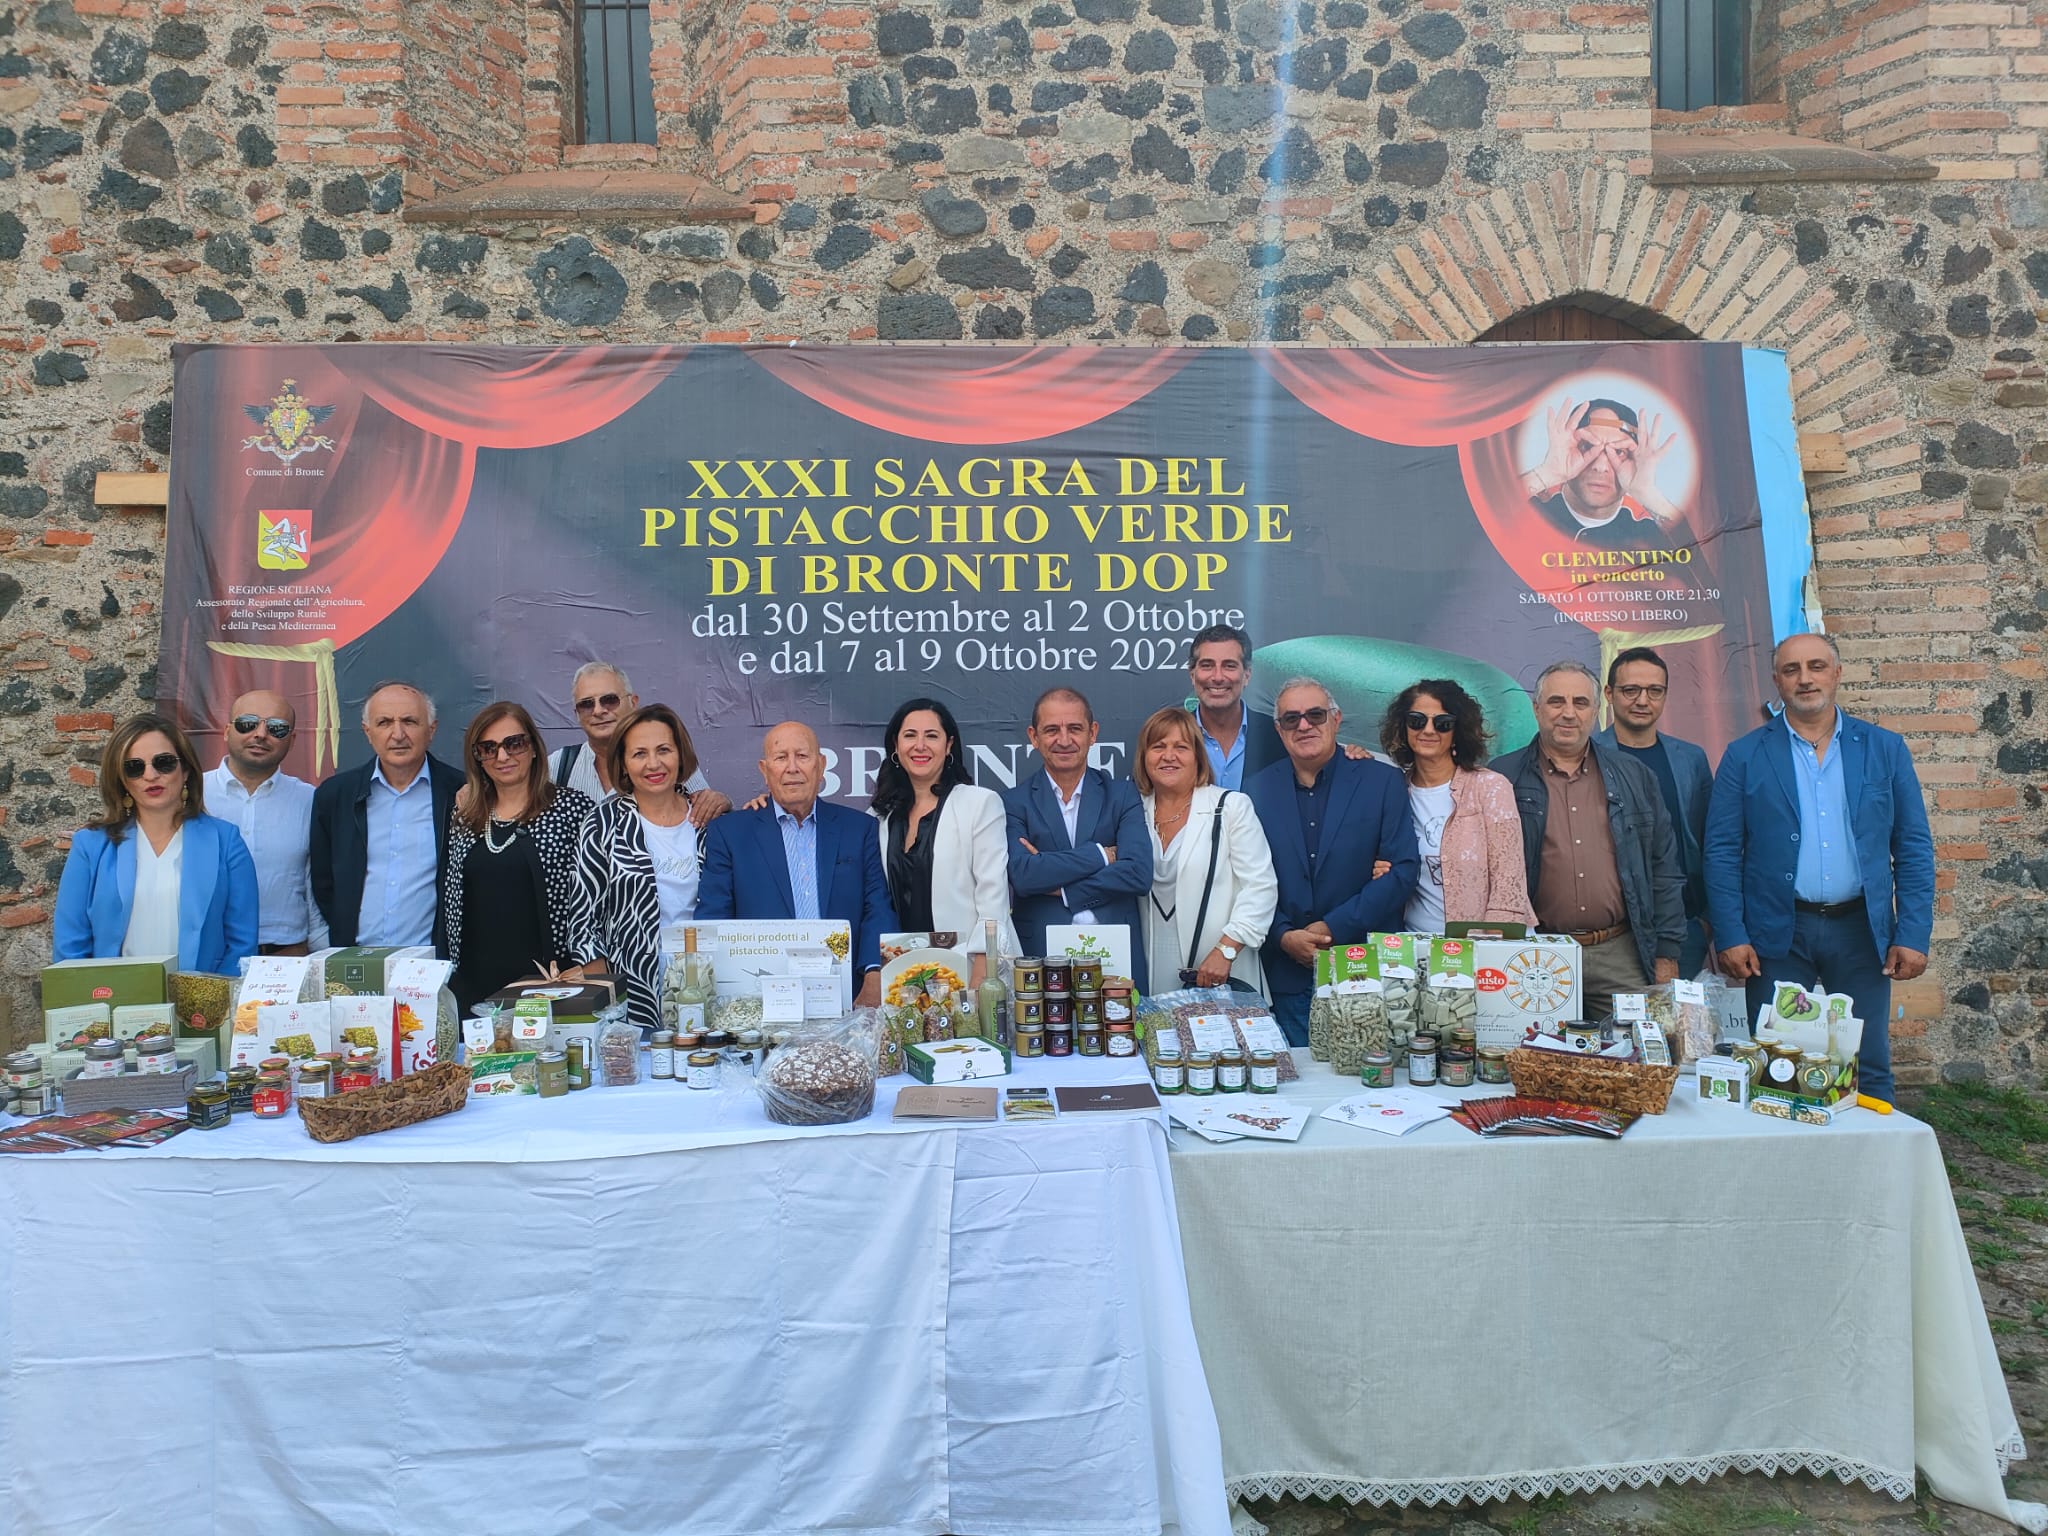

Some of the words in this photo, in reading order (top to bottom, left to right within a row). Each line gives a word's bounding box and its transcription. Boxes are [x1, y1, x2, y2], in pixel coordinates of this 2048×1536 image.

[245, 467, 283, 477] Comune
[284, 466, 293, 477] di
[295, 467, 325, 477] Bronte
[686, 460, 849, 499] XXXI
[874, 458, 1098, 498] SAGRA
[1118, 457, 1246, 496] DEL
[640, 505, 1049, 548] PISTACCHIO
[1071, 503, 1292, 545] VERDE
[1541, 548, 1692, 568] CLEMENTINO
[706, 556, 778, 596] DI
[800, 553, 1072, 595] BRONTE
[1097, 552, 1229, 593] DOP
[1571, 570, 1590, 584] in
[1593, 568, 1665, 583] concerto
[228, 585, 276, 595] REGIONE
[278, 585, 332, 595] SICILIANA
[1519, 591, 1574, 604] SABATO
[1587, 589, 1653, 603] OTTOBRE
[1655, 588, 1685, 601] ORE
[1688, 588, 1720, 602] 21,30
[195, 598, 245, 607] Assessorato
[247, 597, 291, 608] Regionale
[231, 609, 254, 618] dello
[256, 609, 295, 621] Sviluppo
[297, 609, 326, 618] Rurale
[691, 603, 749, 637] dal
[763, 603, 809, 636] 30
[822, 601, 1010, 635] Settembre
[1024, 600, 1054, 633] al
[1069, 600, 1090, 632] 2
[1104, 598, 1245, 632] Ottobre
[1554, 610, 1628, 624] (INGRESSO
[1632, 608, 1689, 623] LIBERO)
[228, 621, 249, 631] della
[251, 621, 277, 631] Pesca
[278, 621, 337, 631] Mediterranea
[738, 651, 757, 674] e
[770, 640, 824, 673] dal
[840, 640, 861, 672] 7
[873, 640, 905, 672] al
[919, 639, 941, 672] 9
[955, 638, 1098, 671] Ottobre
[718, 932, 755, 943] migliori
[758, 932, 798, 945] prodotti
[800, 932, 809, 941] al
[729, 946, 779, 957] pistacchio
